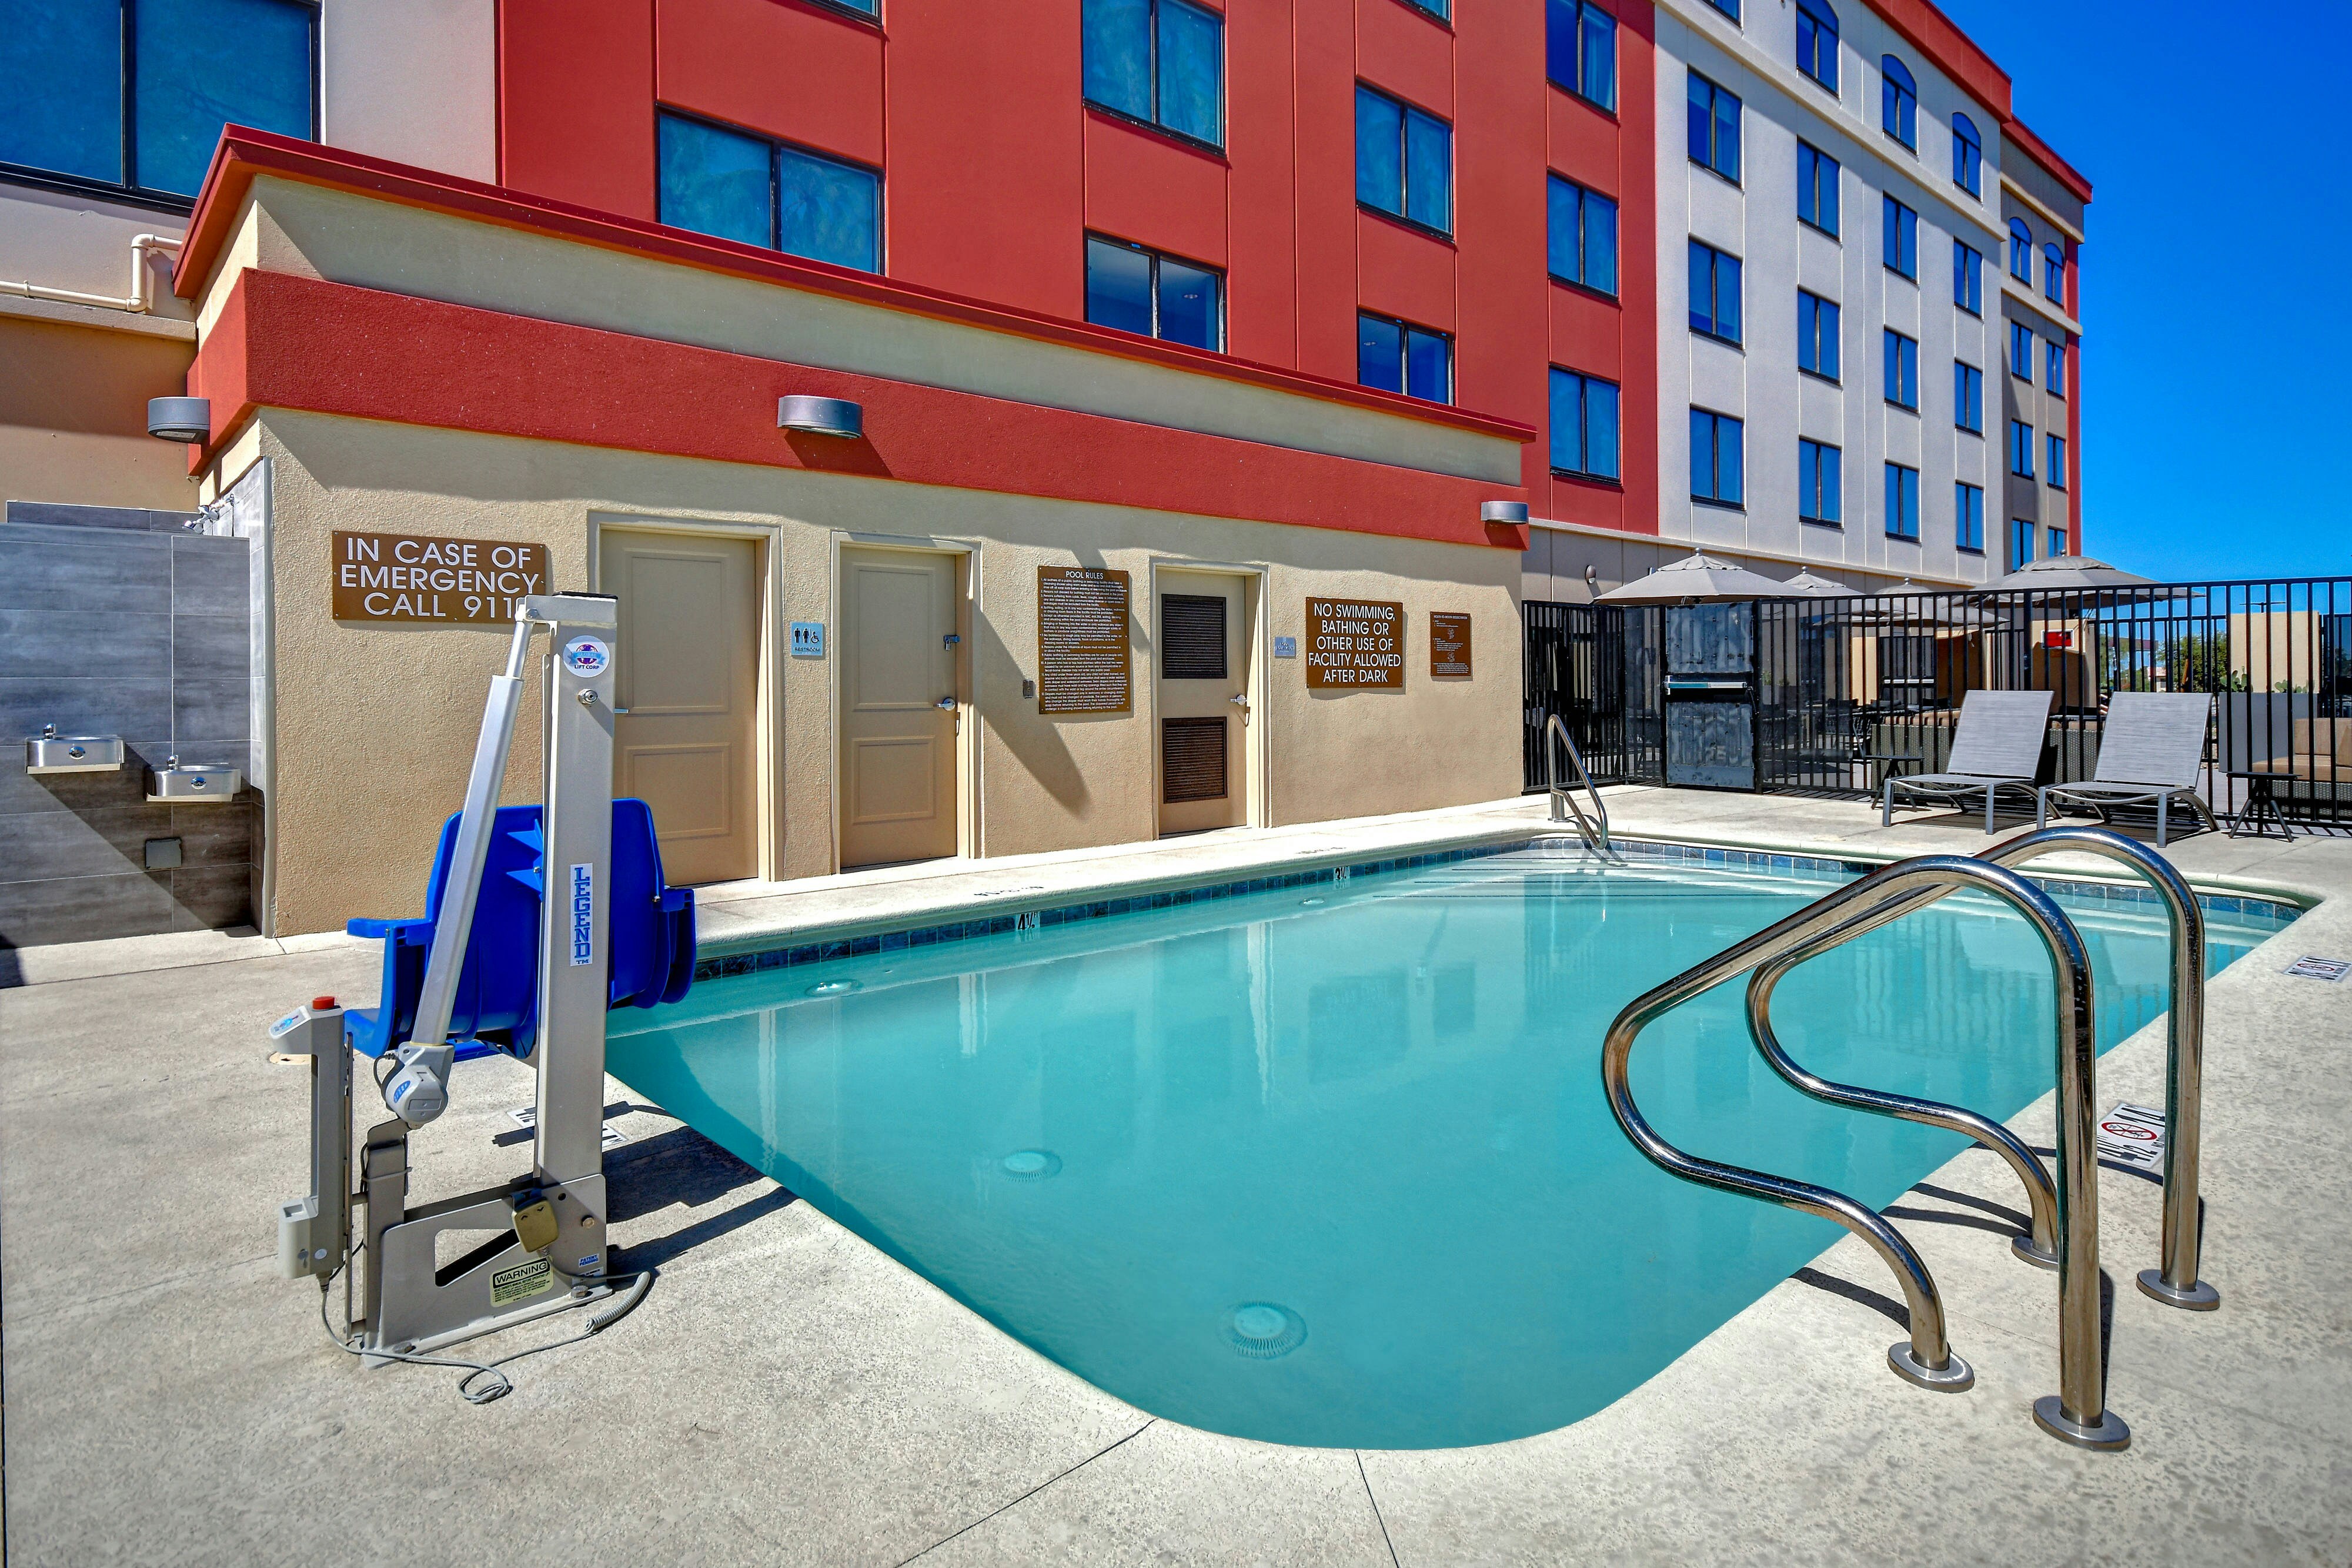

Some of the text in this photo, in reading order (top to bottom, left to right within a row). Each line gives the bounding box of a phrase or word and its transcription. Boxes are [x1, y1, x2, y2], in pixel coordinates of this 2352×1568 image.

[347, 537, 531, 569] IN CASE OF
[342, 565, 539, 594] EMERGENCY
[364, 593, 512, 618] CALL 911
[1314, 603, 1395, 621] NO SWIMMING,
[1322, 620, 1389, 635] BATHING OR
[1317, 636, 1394, 651] OTHER USE OF
[1308, 653, 1401, 667] FACILITY ALLOWED
[1323, 669, 1388, 683] AFTER DARK
[574, 867, 590, 958] LEGEND
[496, 1262, 547, 1284] WARNING
